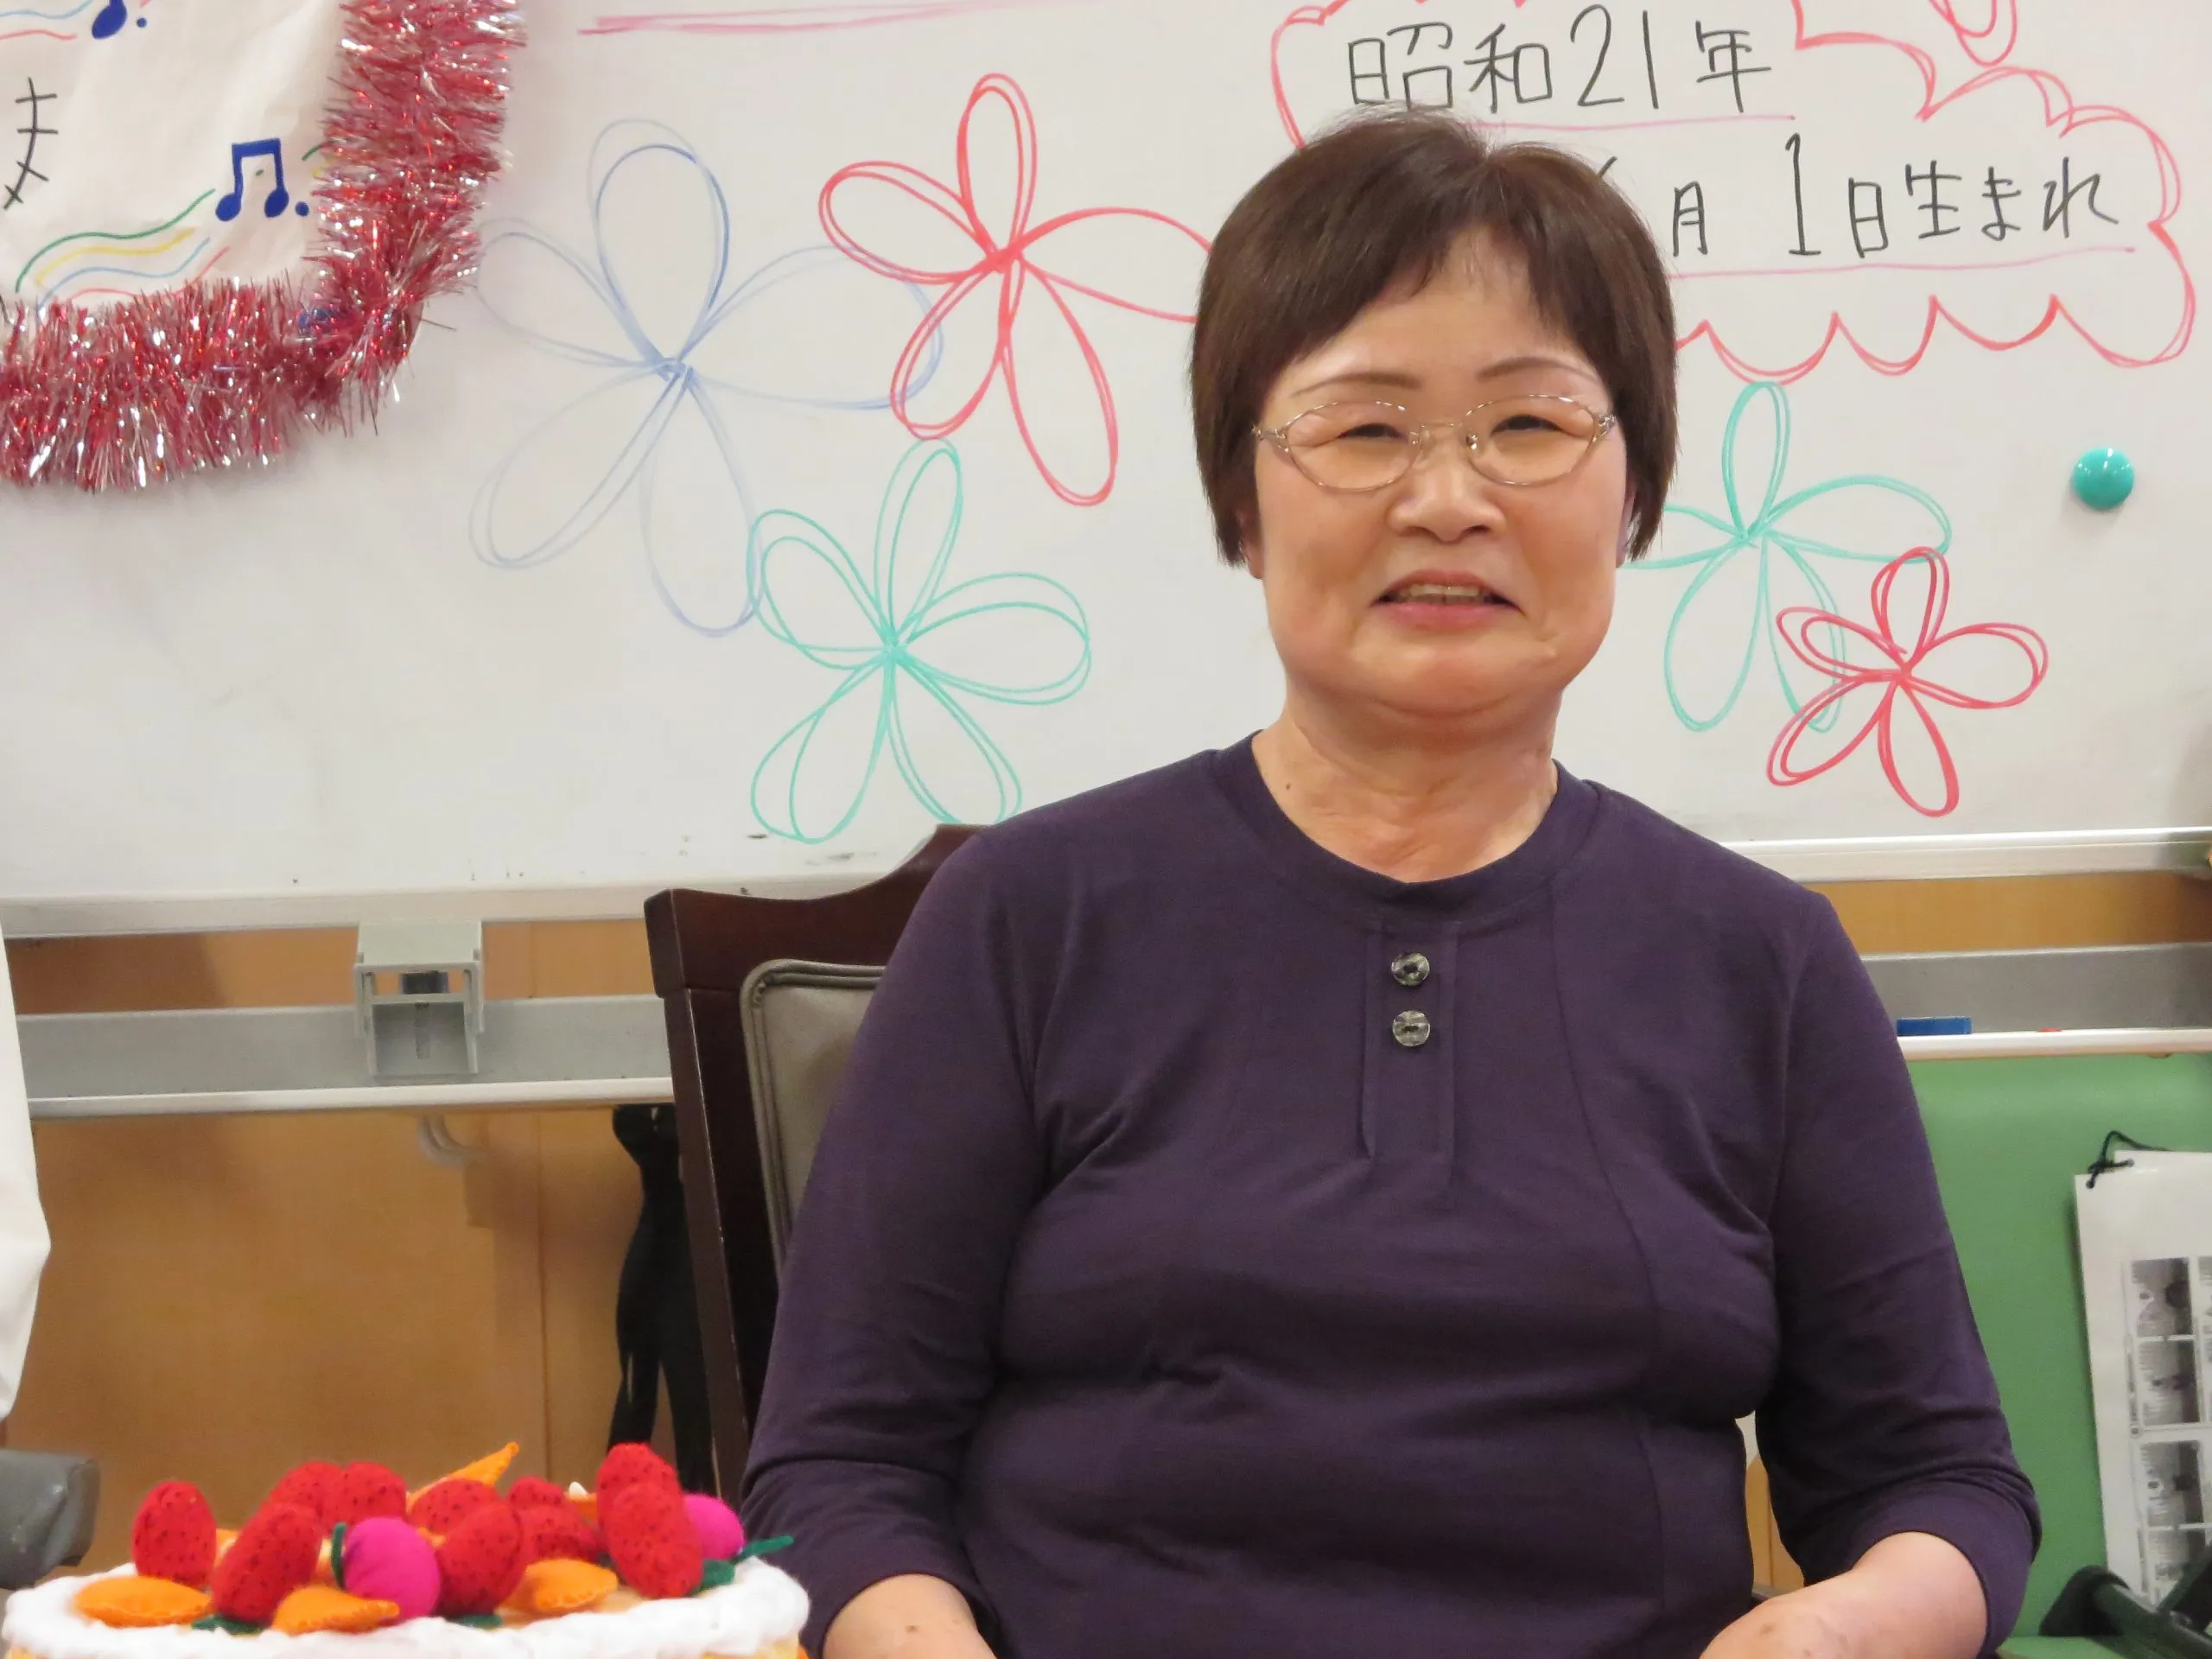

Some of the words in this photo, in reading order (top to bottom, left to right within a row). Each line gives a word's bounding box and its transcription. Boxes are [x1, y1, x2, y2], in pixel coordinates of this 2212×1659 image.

[1347, 3, 1772, 113] 昭和21年
[1598, 132, 2119, 258] 月1日生まれ
